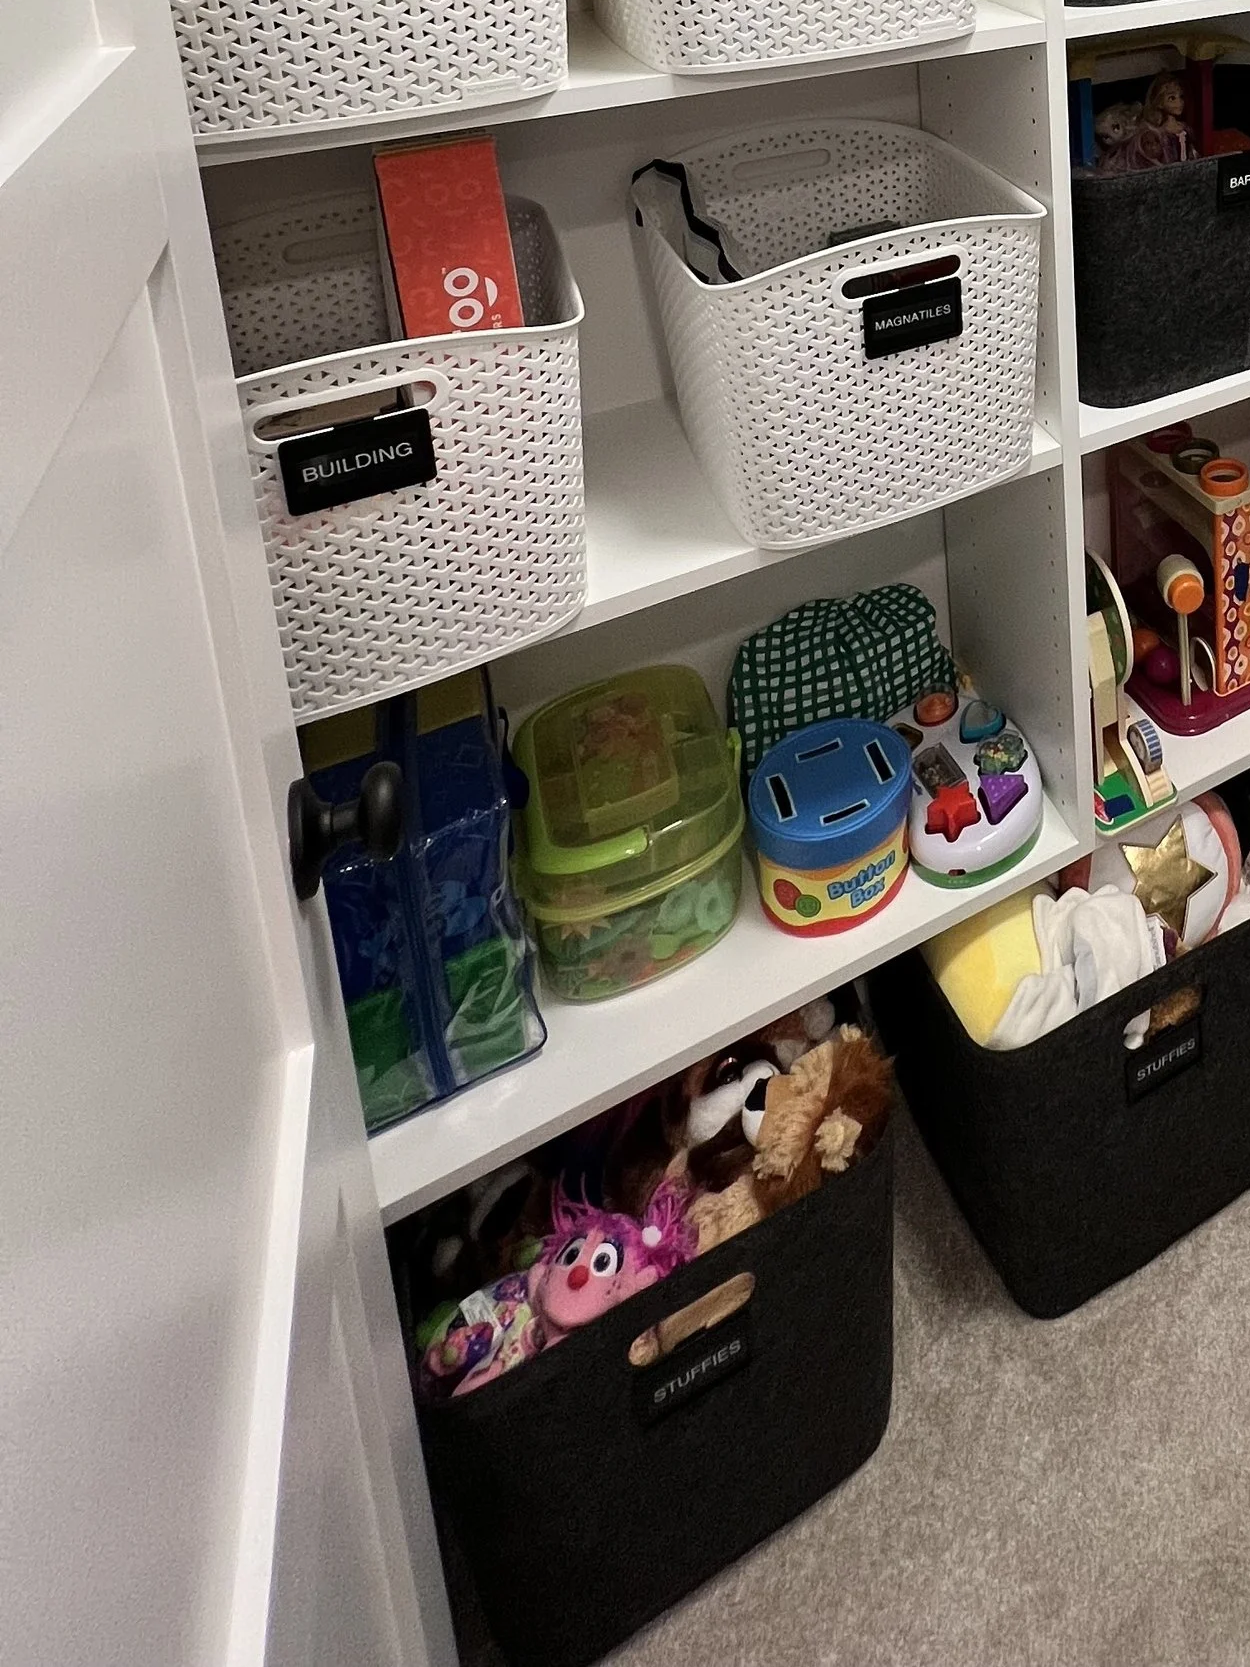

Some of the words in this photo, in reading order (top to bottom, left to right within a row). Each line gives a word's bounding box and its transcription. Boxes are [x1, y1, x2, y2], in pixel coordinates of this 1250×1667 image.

[874, 303, 952, 332] MAGNATILES
[301, 441, 414, 484] BUILDING
[827, 850, 897, 901] Button
[849, 877, 887, 909] Box
[1136, 1036, 1197, 1083] STUFFIES
[652, 1339, 742, 1405] STUFFIES
